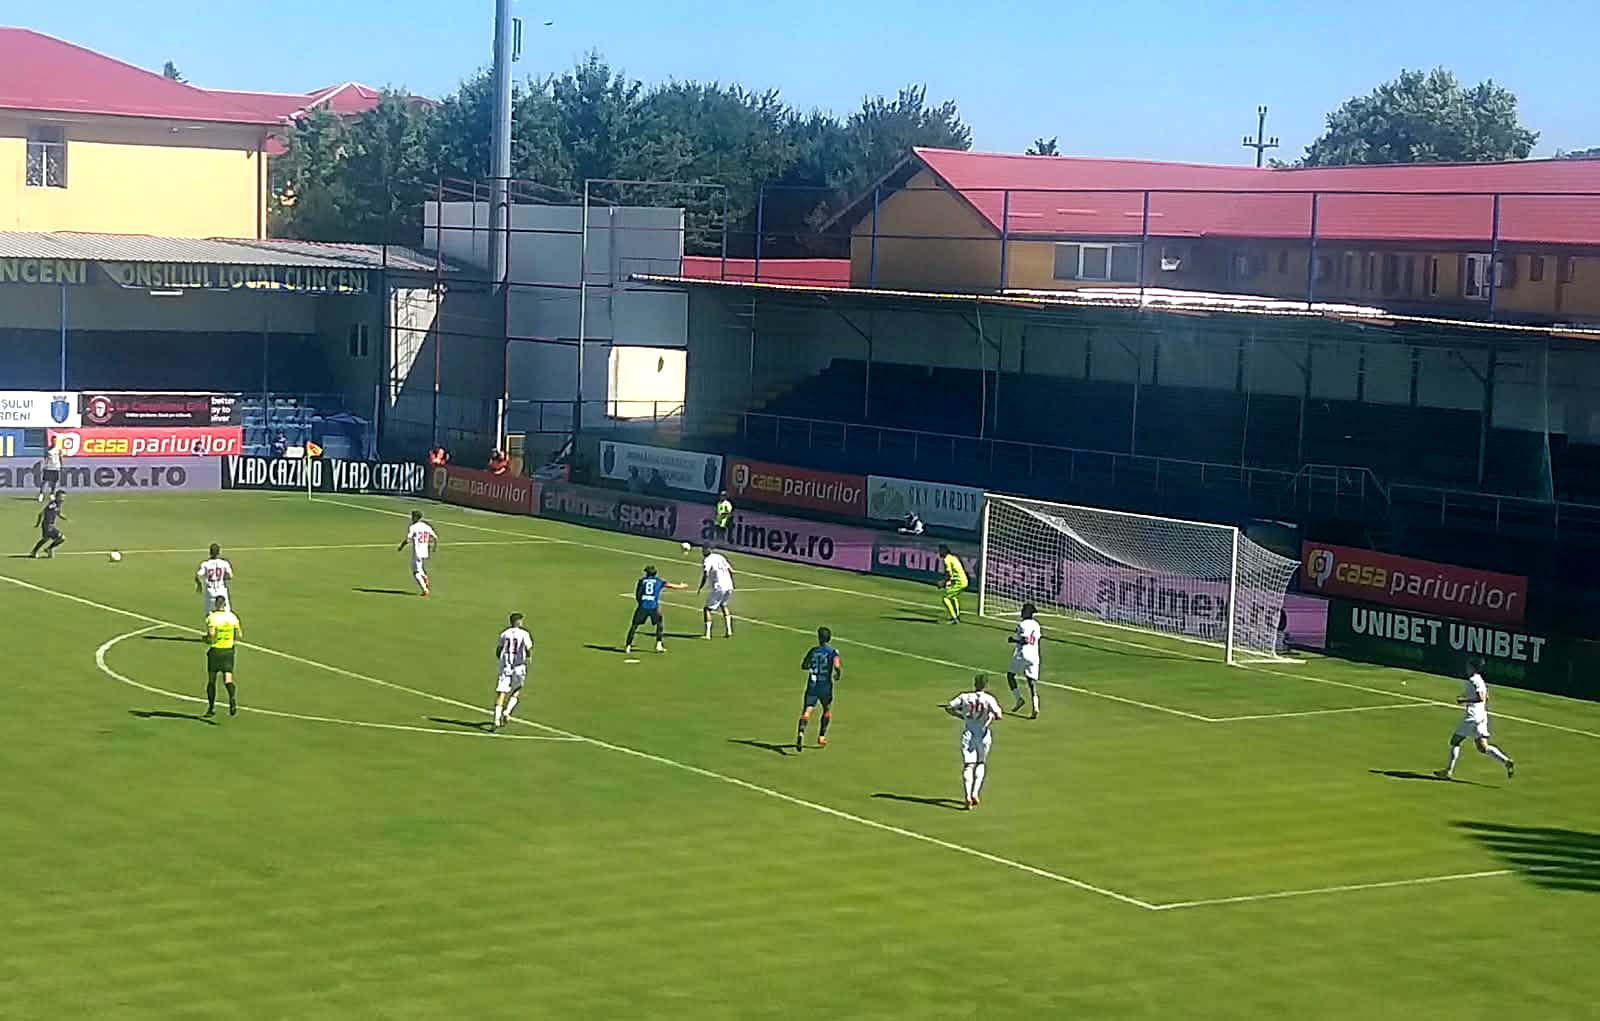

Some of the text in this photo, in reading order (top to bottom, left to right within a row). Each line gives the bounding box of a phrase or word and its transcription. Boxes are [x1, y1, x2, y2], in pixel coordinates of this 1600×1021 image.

[121, 262, 209, 288] ONSILIUL
[219, 263, 280, 289] LOCAL
[83, 434, 236, 456] casa pariurilor
[0, 460, 187, 488] artmex.ro
[229, 455, 322, 488] VLAD CAZINO
[331, 459, 425, 491] VLAD CAZINO
[471, 480, 527, 502] pariurilor
[783, 477, 862, 504] pariurilor
[935, 490, 977, 513] GARDEN
[620, 503, 672, 530] sport
[879, 546, 977, 578] artimx
[646, 581, 654, 595] 8
[1335, 560, 1518, 612] casa pariurilor
[504, 638, 518, 655] 11
[1351, 607, 1546, 663] UNIBET UNIBET
